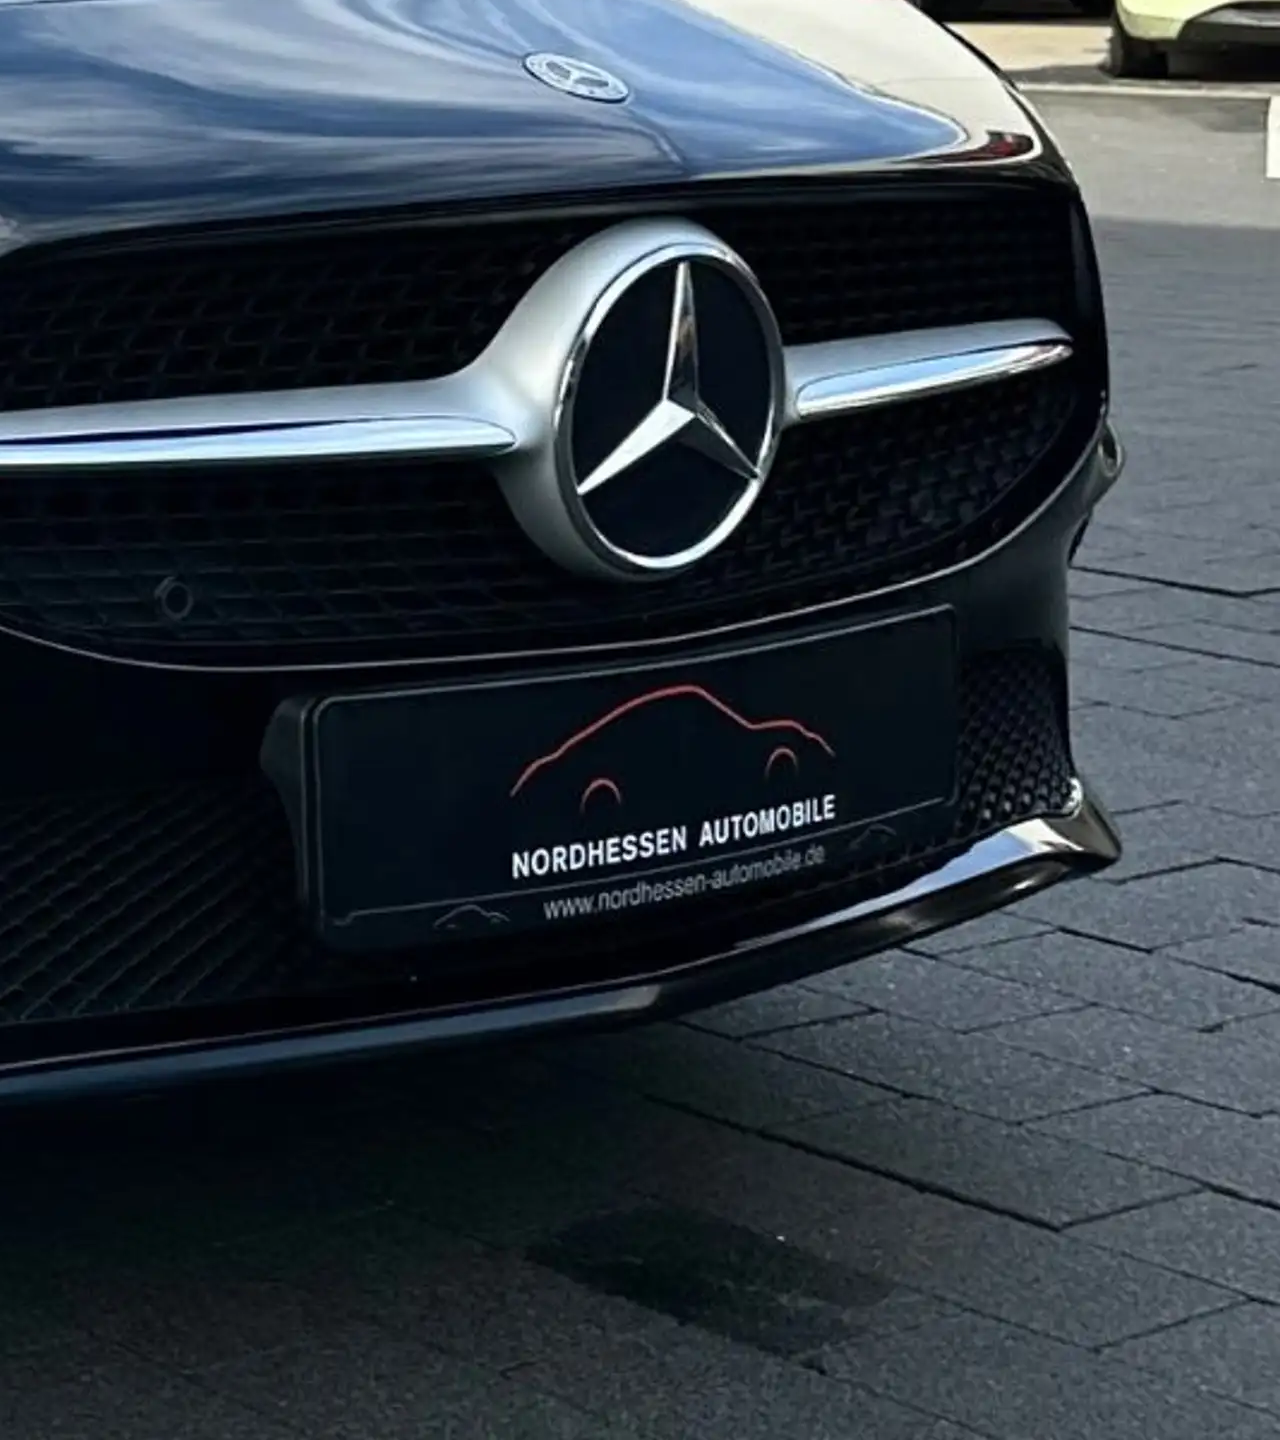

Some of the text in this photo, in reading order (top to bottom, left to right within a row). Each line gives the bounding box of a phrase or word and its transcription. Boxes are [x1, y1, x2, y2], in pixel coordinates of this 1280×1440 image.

[512, 794, 836, 879] NORDHESSEN AUTOMOBILE
[543, 844, 826, 921] www.nordhessen-automobile.de
